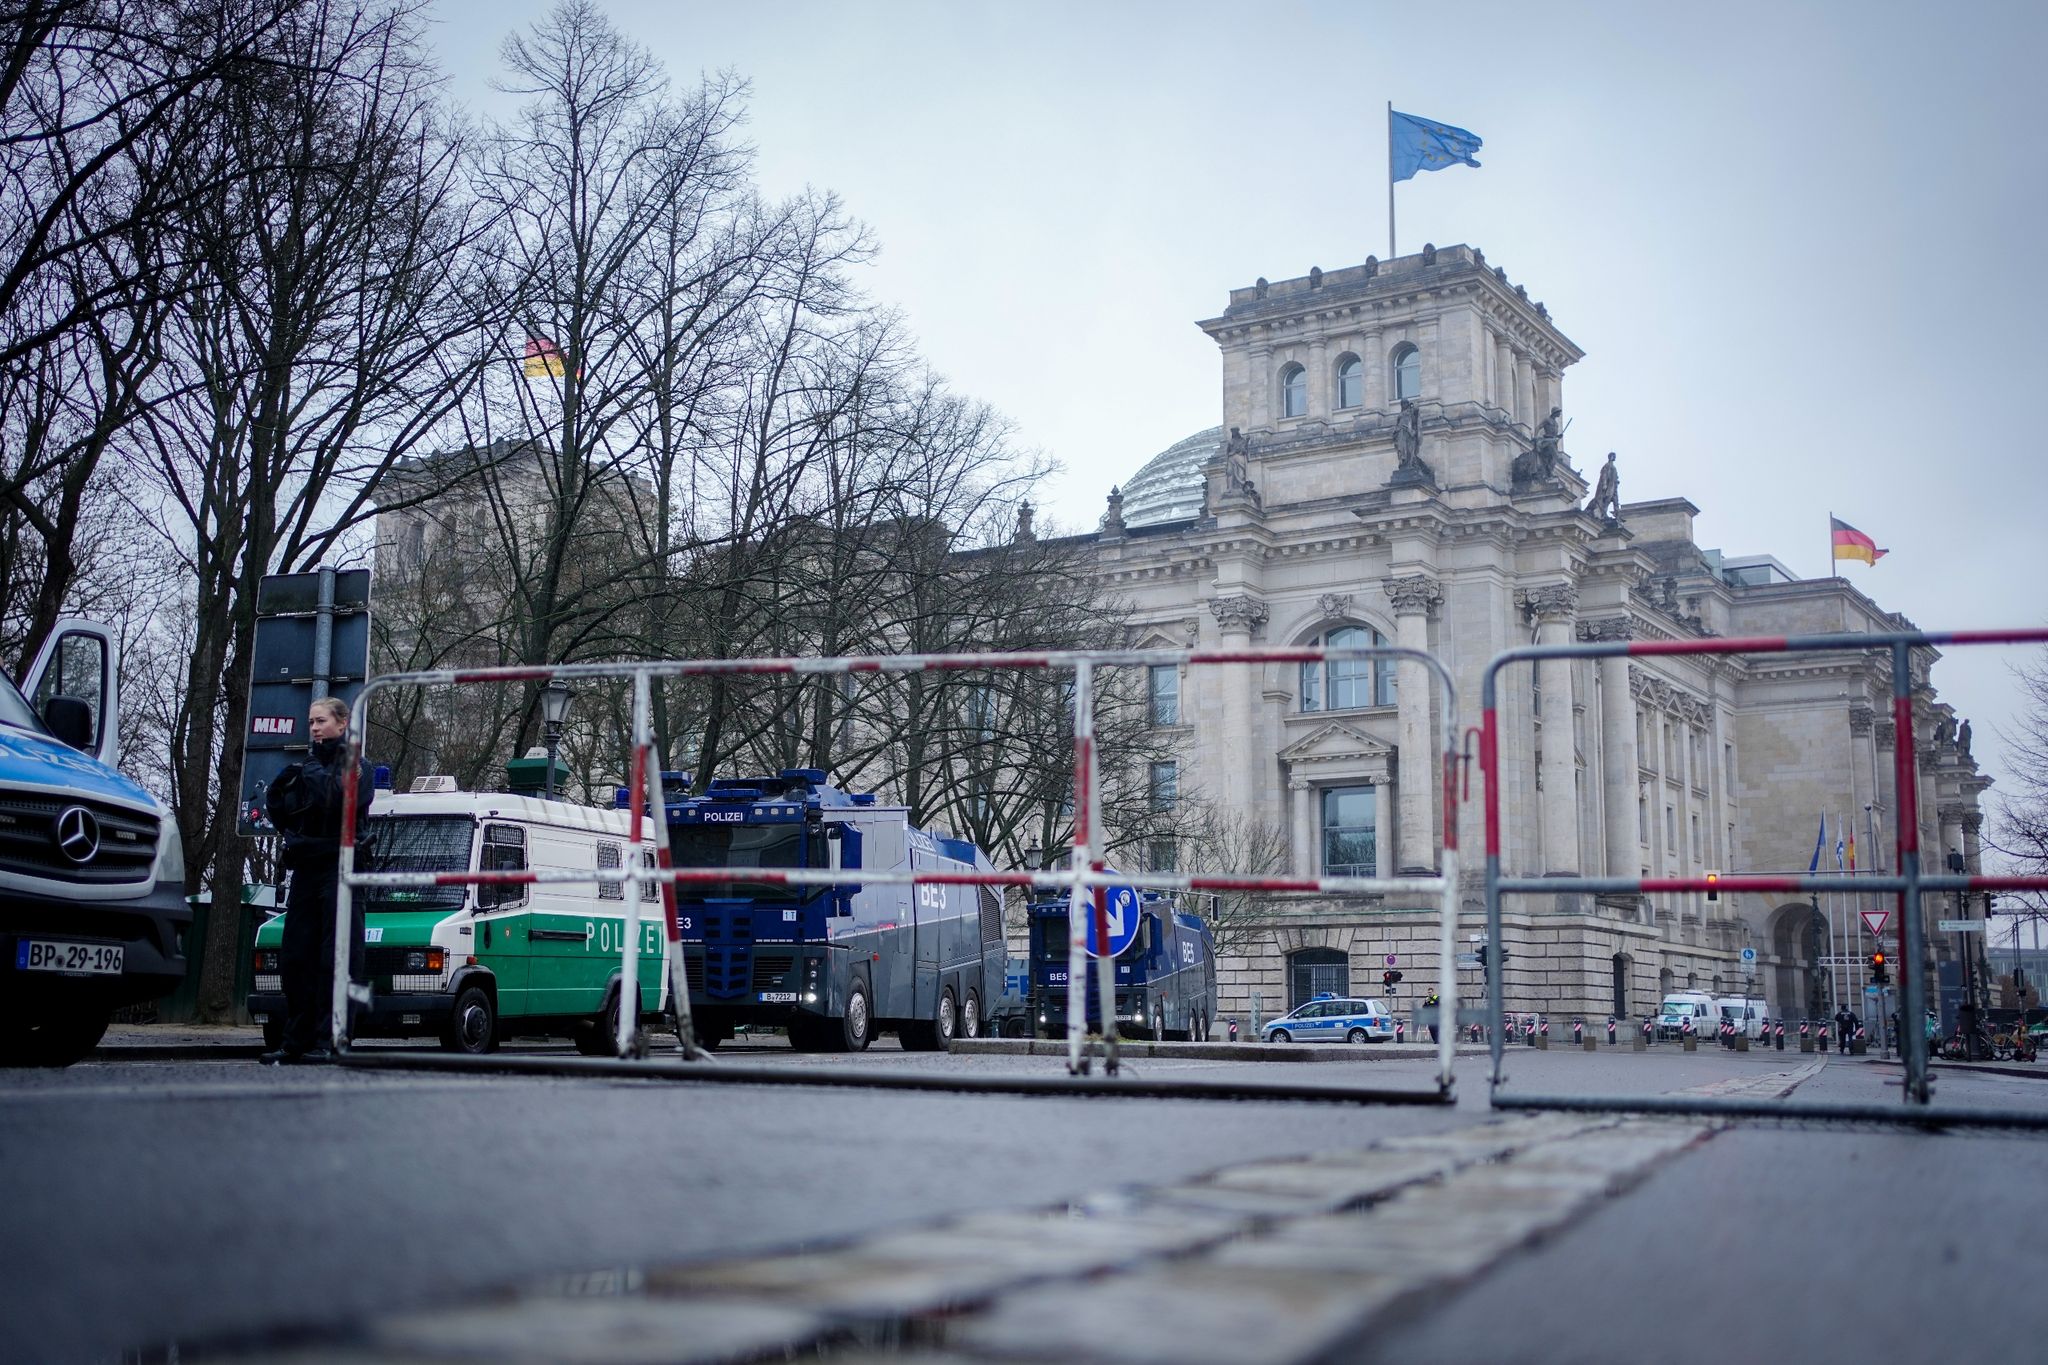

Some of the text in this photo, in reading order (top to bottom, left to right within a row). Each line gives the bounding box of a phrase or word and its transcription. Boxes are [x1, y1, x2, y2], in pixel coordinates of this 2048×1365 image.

[253, 717, 294, 734] MLM
[704, 812, 743, 821] POLIZEI
[675, 917, 692, 929] E3
[585, 921, 662, 955] POLEI
[1182, 941, 1195, 964] BE5
[1049, 973, 1068, 981] BE5
